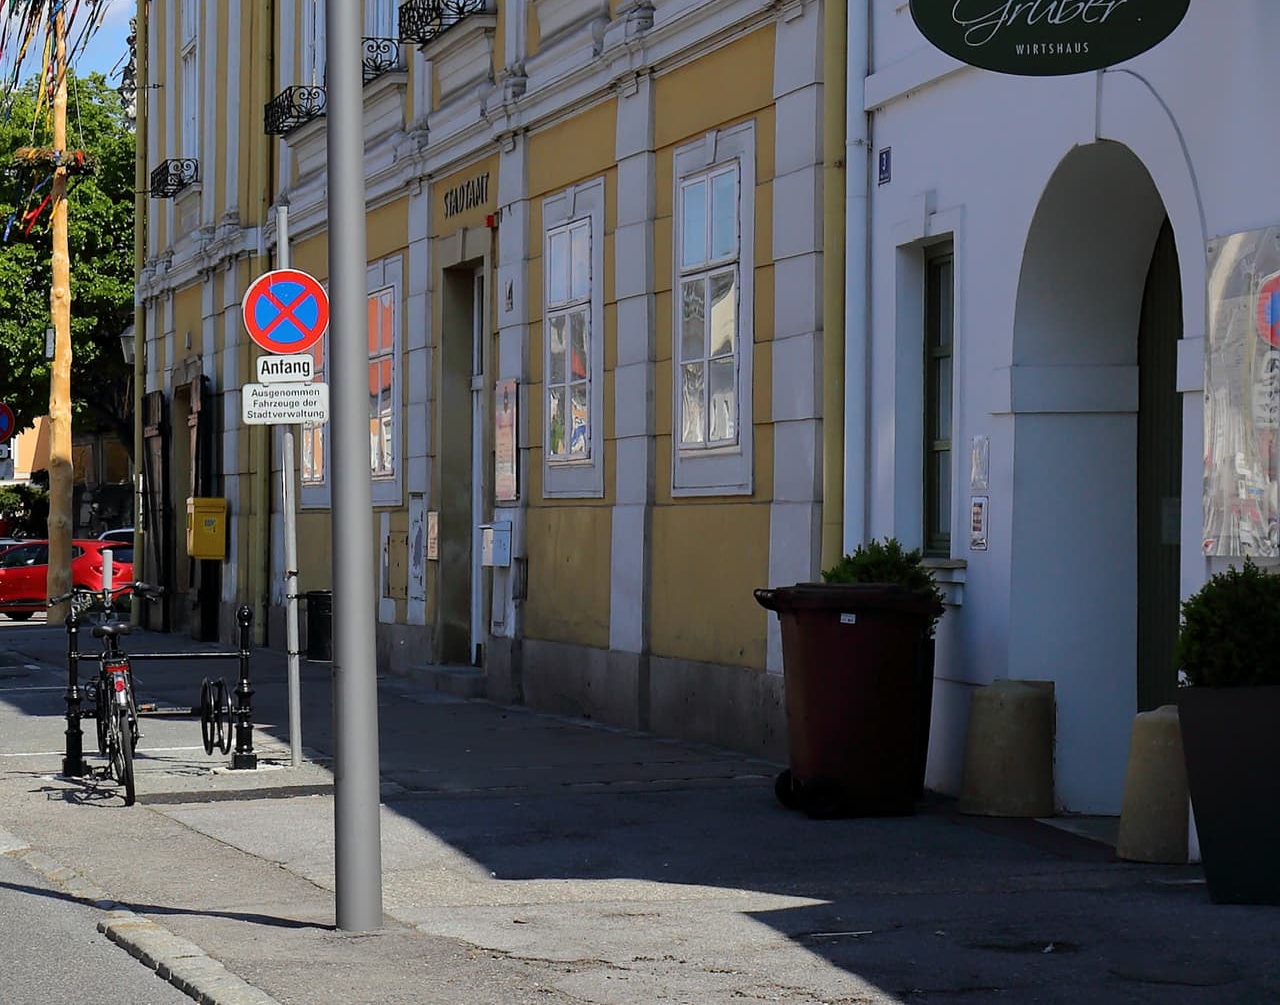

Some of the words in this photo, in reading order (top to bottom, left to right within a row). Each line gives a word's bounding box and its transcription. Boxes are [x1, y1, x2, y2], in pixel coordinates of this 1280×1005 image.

[1015, 42, 1090, 55] WIRTSHAUS
[443, 171, 490, 219] STADTAMT
[260, 359, 310, 377] Anfang
[251, 388, 320, 399] Ausgenommen
[253, 399, 300, 409] Fahrzeuge
[302, 398, 318, 407] der
[247, 409, 325, 419] Stadtverwaltung
